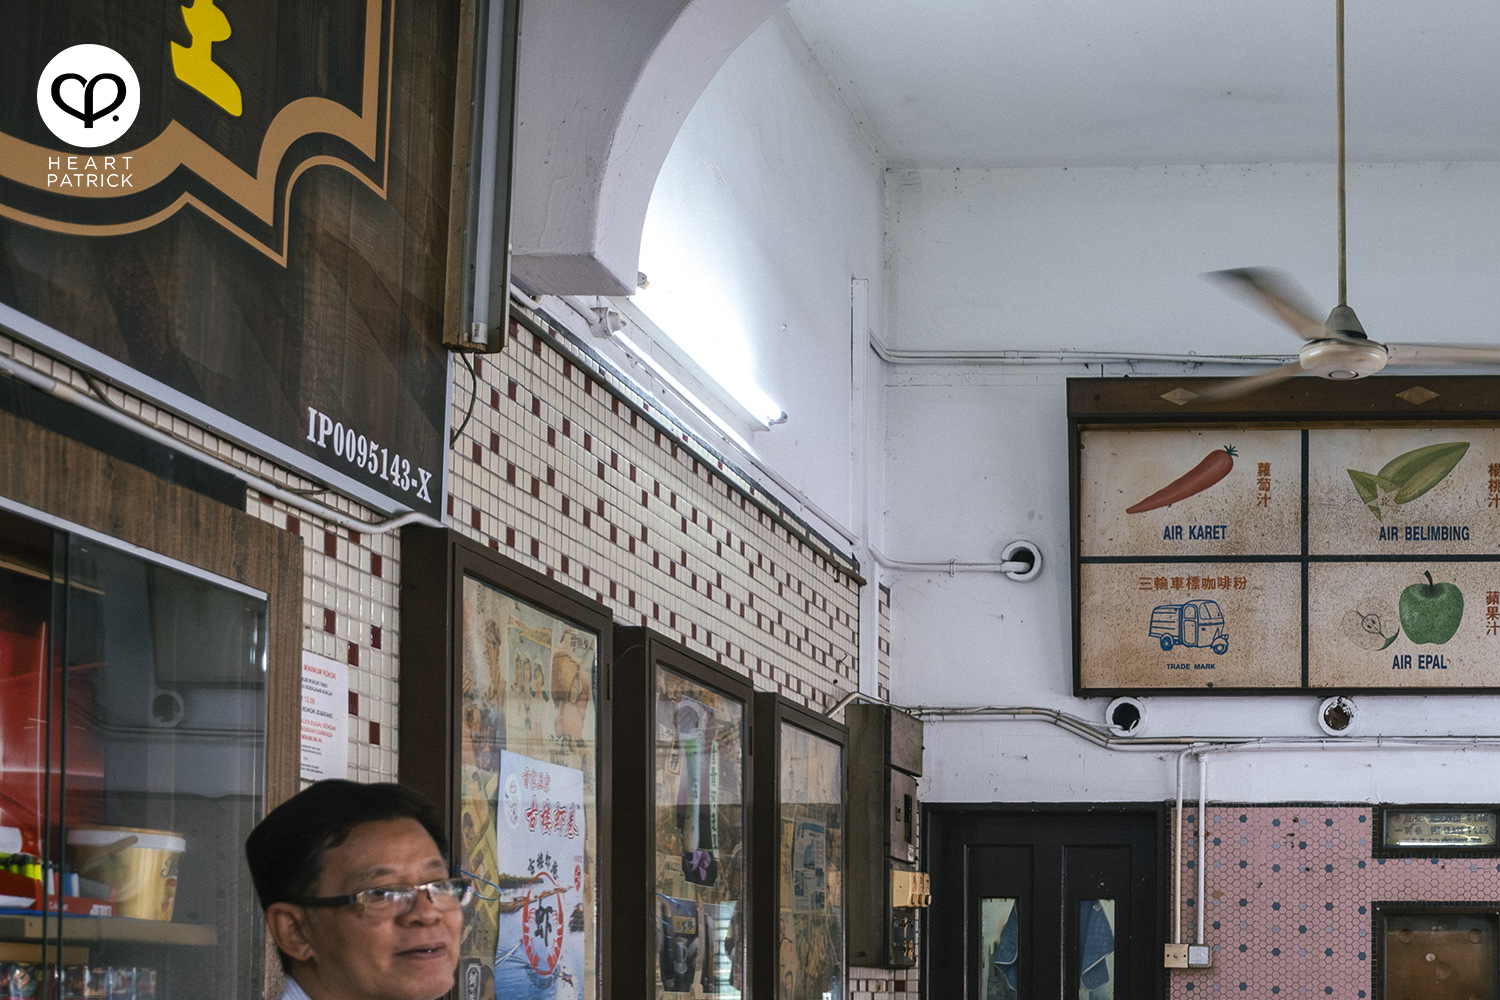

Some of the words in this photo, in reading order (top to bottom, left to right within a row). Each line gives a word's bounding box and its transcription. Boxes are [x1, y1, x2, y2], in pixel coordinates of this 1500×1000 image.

[306, 406, 432, 503] IP0095143-X
[1163, 525, 1182, 540] AIR
[1189, 525, 1227, 540] KARET
[1379, 527, 1398, 541] AIR
[1405, 526, 1470, 541] BELIMBING
[1138, 576, 1247, 590] 三輪車標咖啡粉
[1485, 591, 1500, 636] 蘋果汁
[1392, 655, 1411, 669] AIR
[1418, 655, 1447, 669] EPAL
